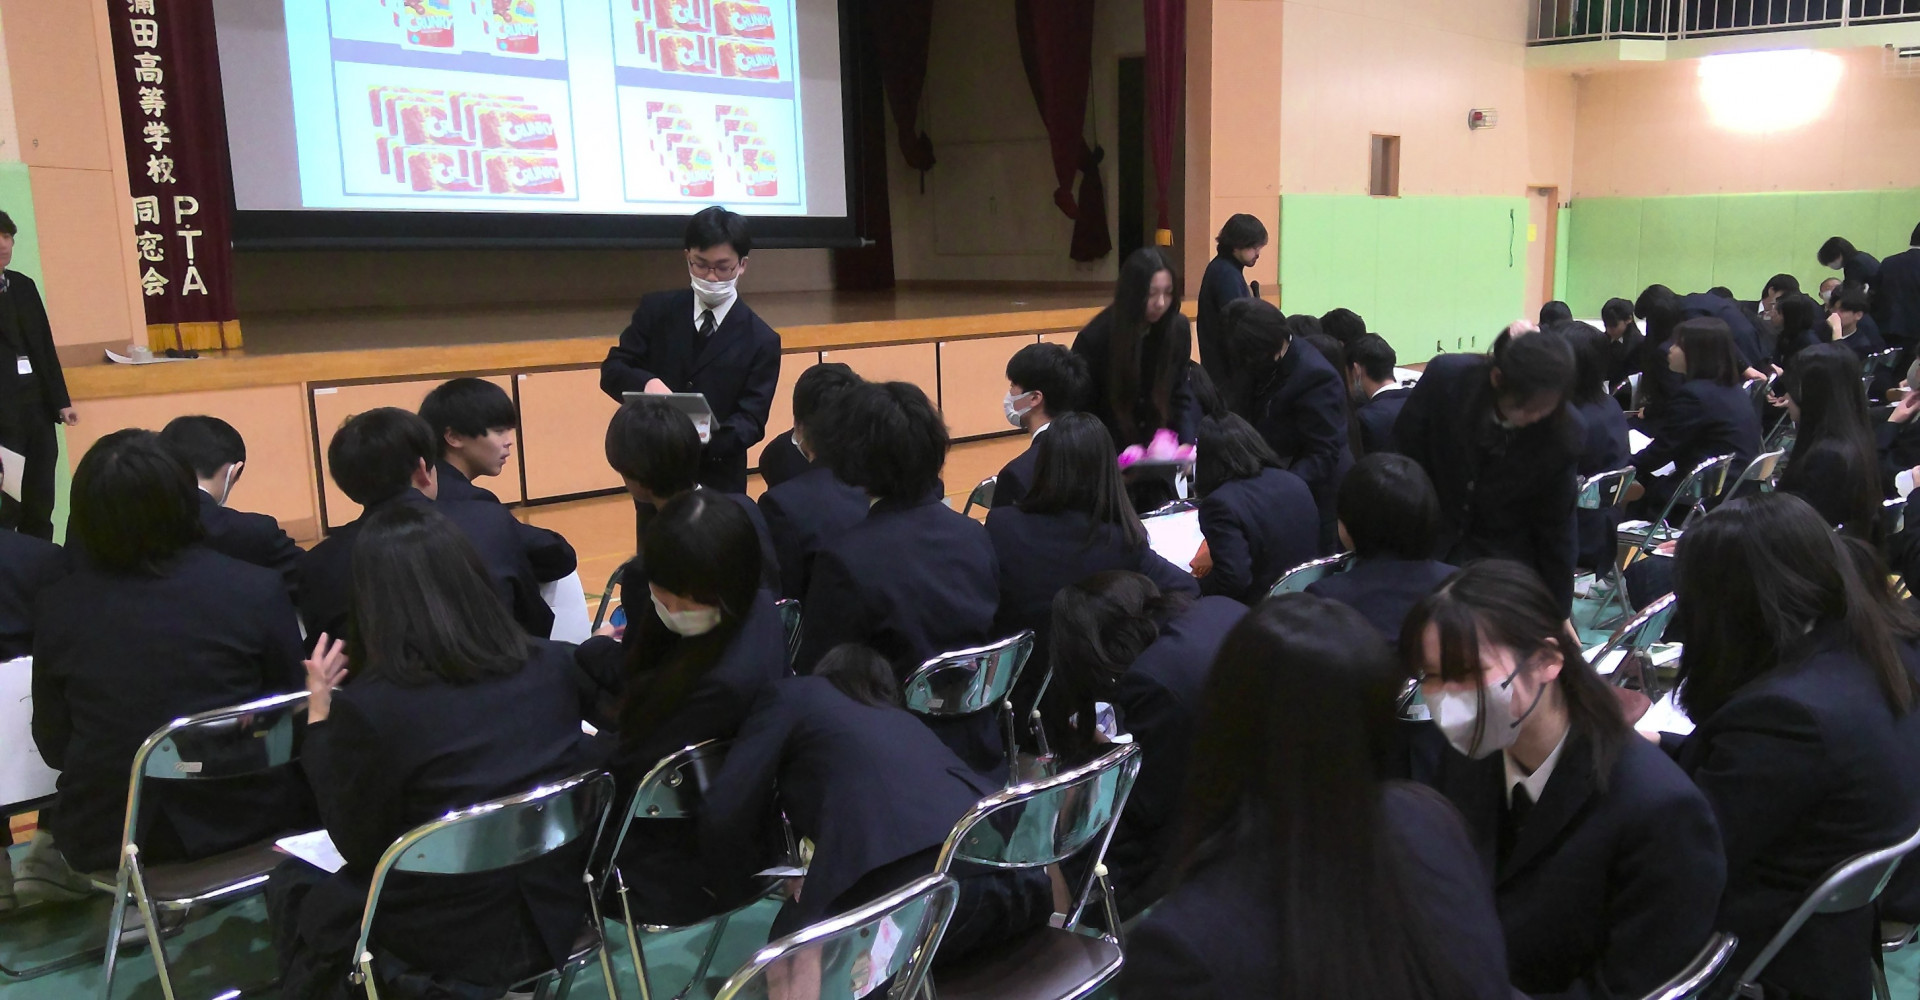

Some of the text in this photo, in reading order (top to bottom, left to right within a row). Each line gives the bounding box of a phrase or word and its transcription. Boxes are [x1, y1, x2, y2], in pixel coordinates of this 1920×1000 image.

[730, 12, 772, 31] CRUNKY
[735, 53, 777, 71] CRUNKY
[501, 121, 553, 142] CRUNKY
[507, 166, 560, 186] CRUNKY
[133, 195, 170, 296] 同窓会
